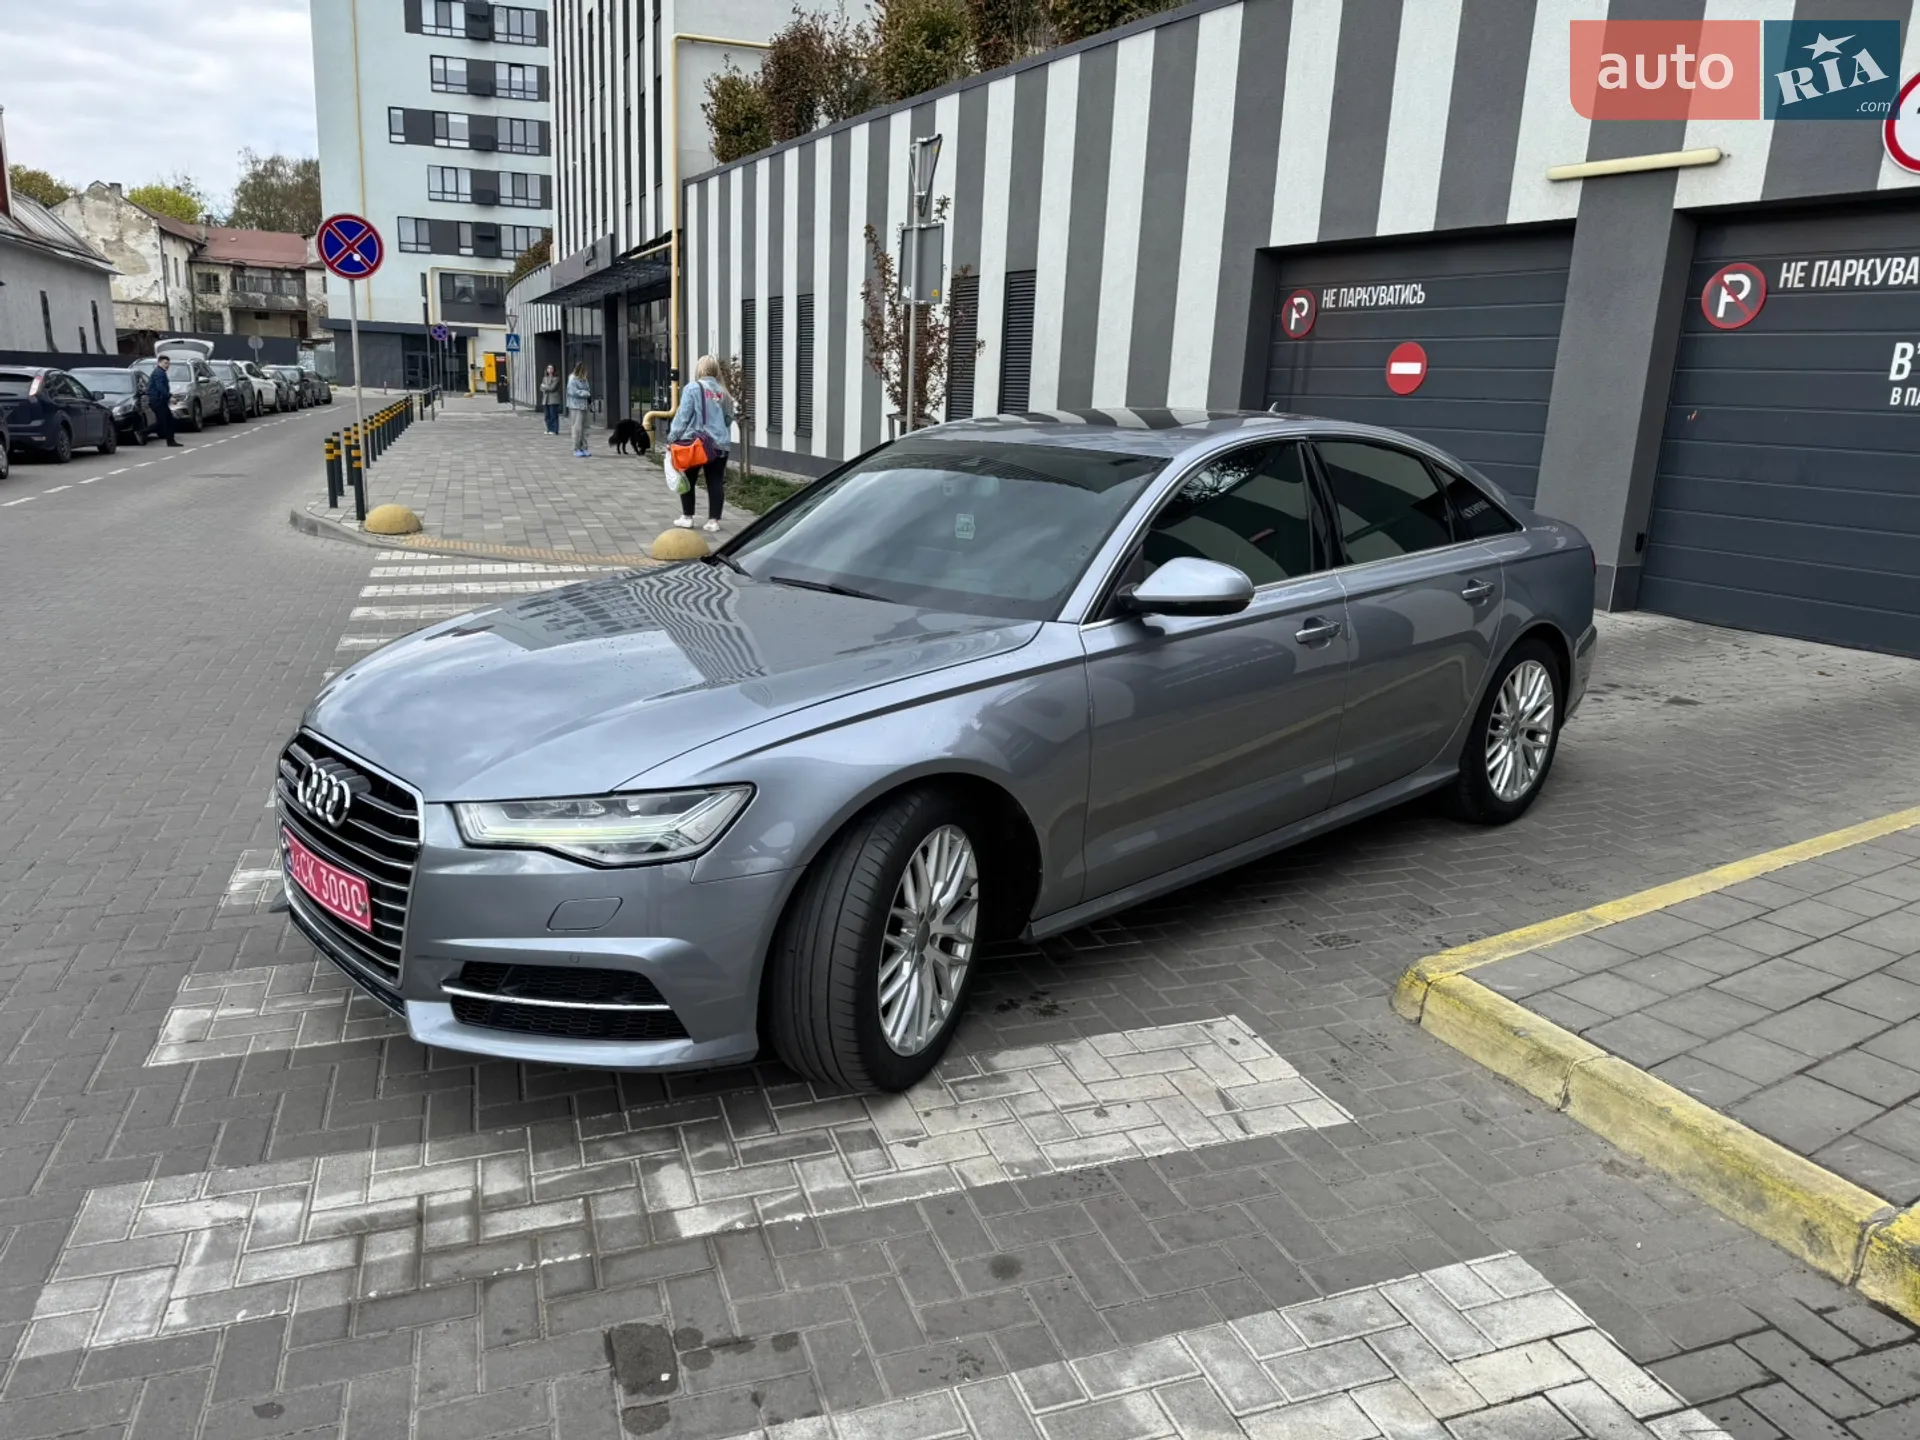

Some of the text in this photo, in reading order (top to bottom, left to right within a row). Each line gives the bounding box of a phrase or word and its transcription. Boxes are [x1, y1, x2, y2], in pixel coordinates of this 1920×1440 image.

[1778, 256, 1920, 288] НЕ ПАРКУВА
[1322, 283, 1426, 309] НЕ ПАРКУВАТИСЬ
[1889, 386, 1902, 406] В
